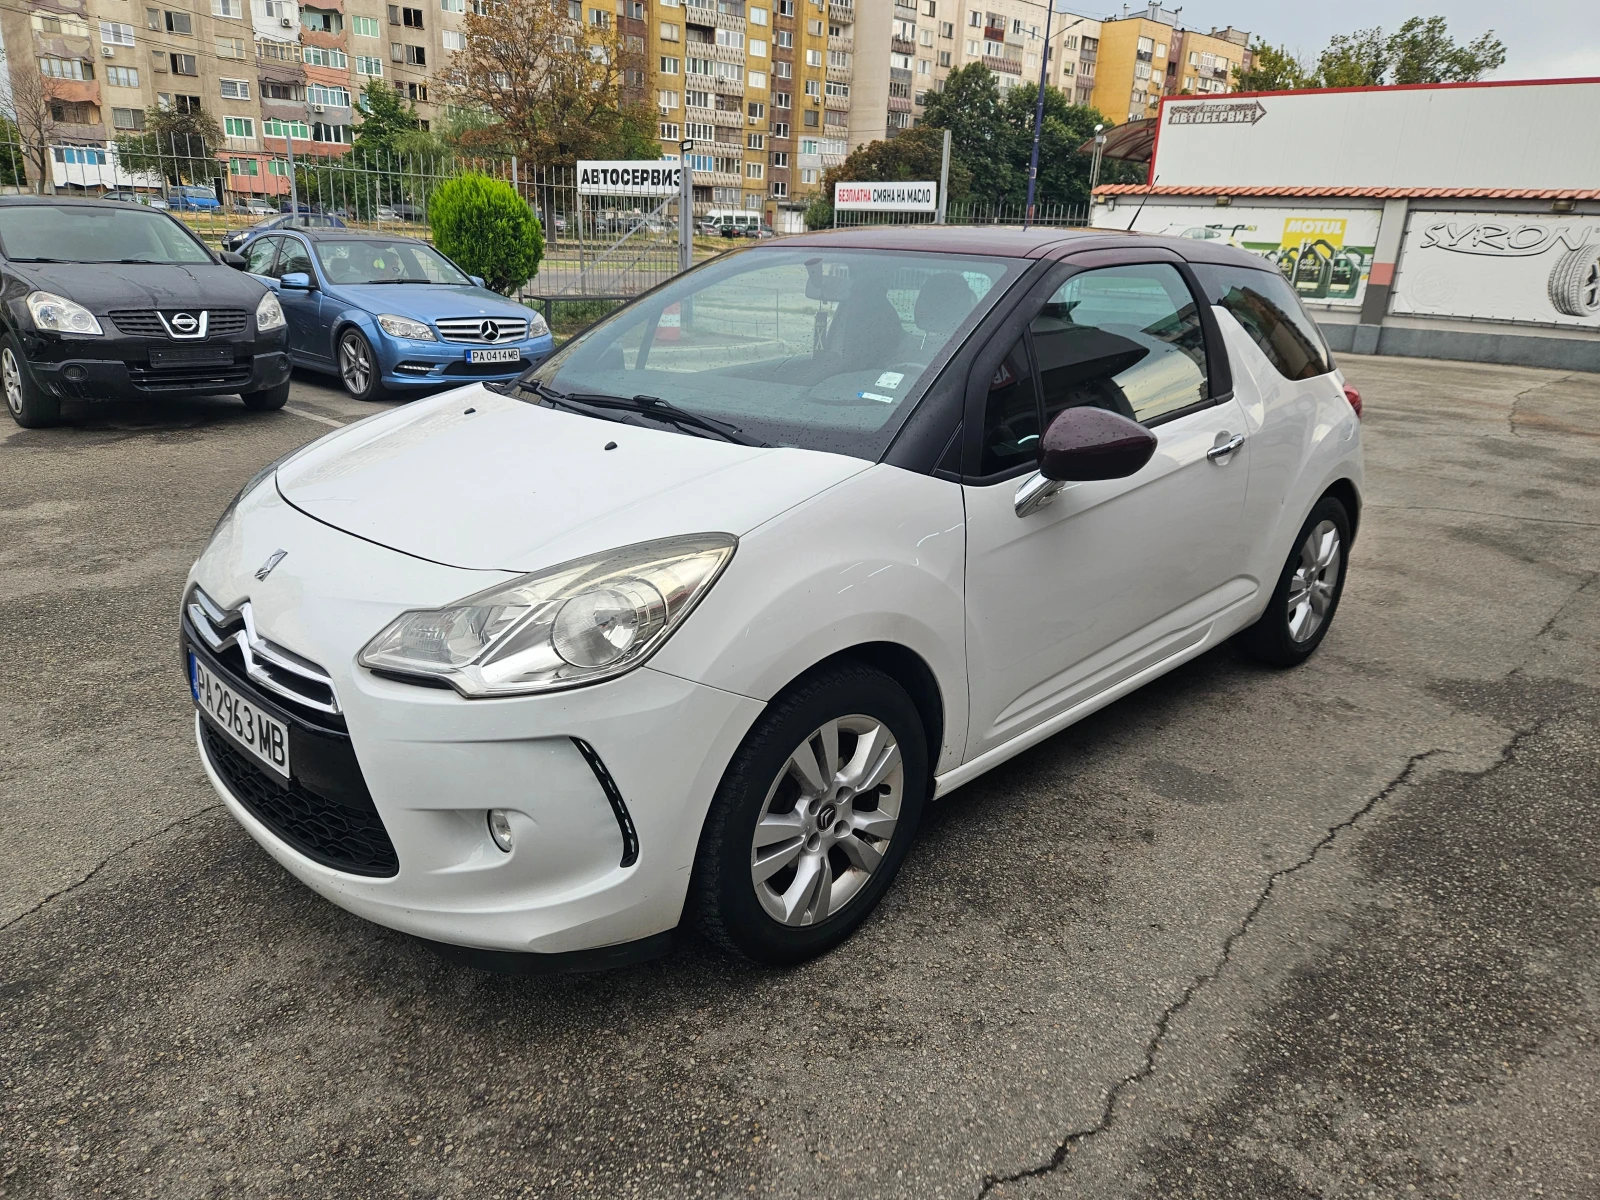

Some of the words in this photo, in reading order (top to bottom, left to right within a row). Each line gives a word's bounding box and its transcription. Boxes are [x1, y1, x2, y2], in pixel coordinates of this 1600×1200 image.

[1172, 110, 1252, 124] АВТОСЕРВИЗ
[838, 188, 871, 203] БЕЗПЛАТНА
[872, 188, 895, 203] СМЯНА
[896, 188, 906, 203] НА
[907, 188, 931, 203] МАСЛО
[1286, 220, 1342, 234] MOTUL
[1420, 222, 1592, 257] SYRON
[197, 662, 214, 711] PA
[215, 682, 255, 745] 2963
[257, 713, 285, 767] MB
